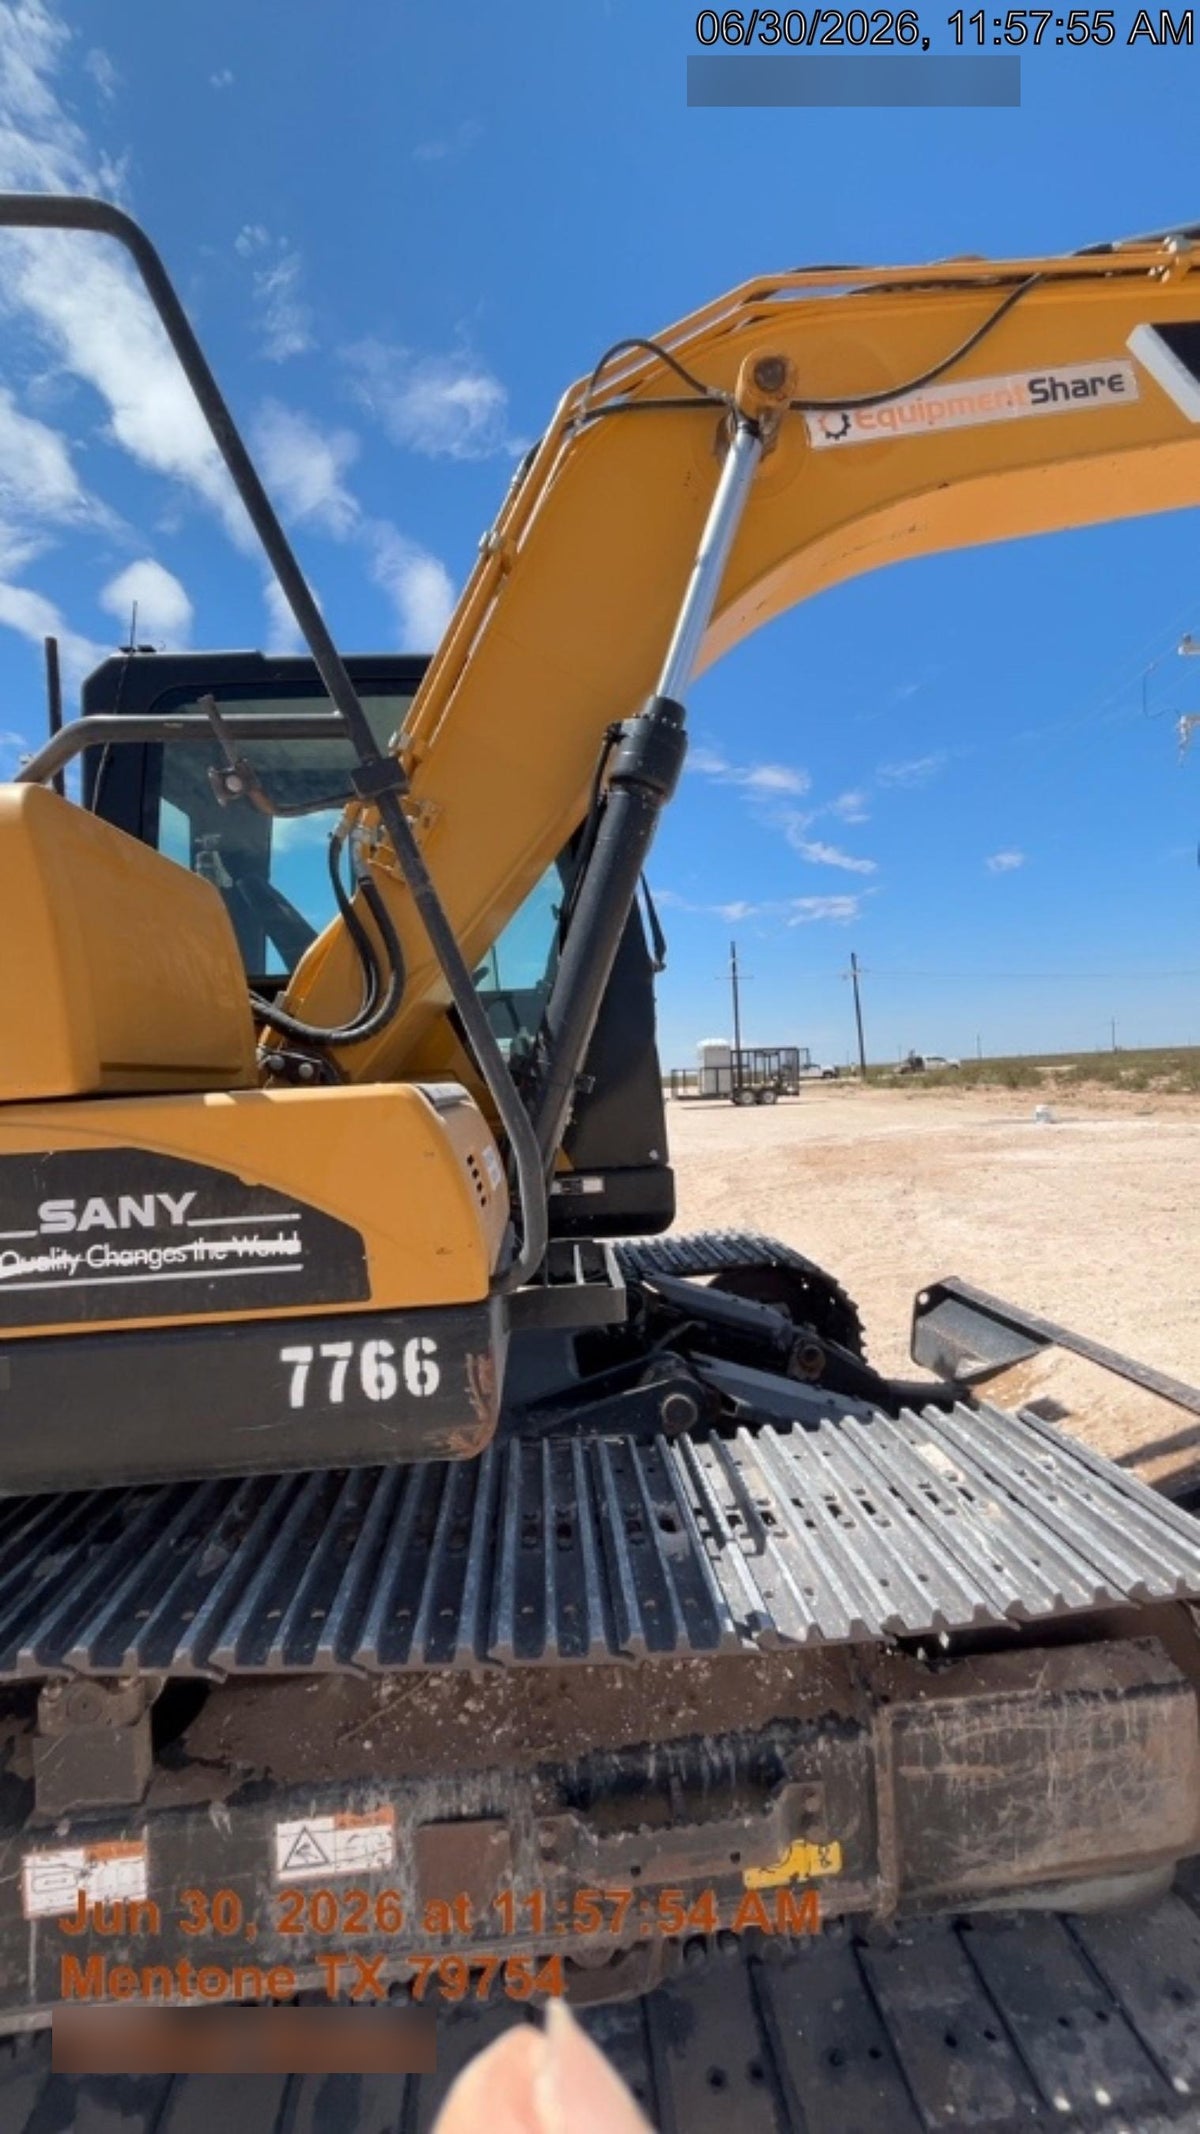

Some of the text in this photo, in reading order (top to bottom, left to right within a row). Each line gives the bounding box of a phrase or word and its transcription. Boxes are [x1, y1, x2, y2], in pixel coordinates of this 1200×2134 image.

[854, 373, 1126, 431] EquipmentShare
[37, 1191, 197, 1234] SANY
[86, 1242, 187, 1270] Changes
[280, 1337, 440, 1408] 7766
